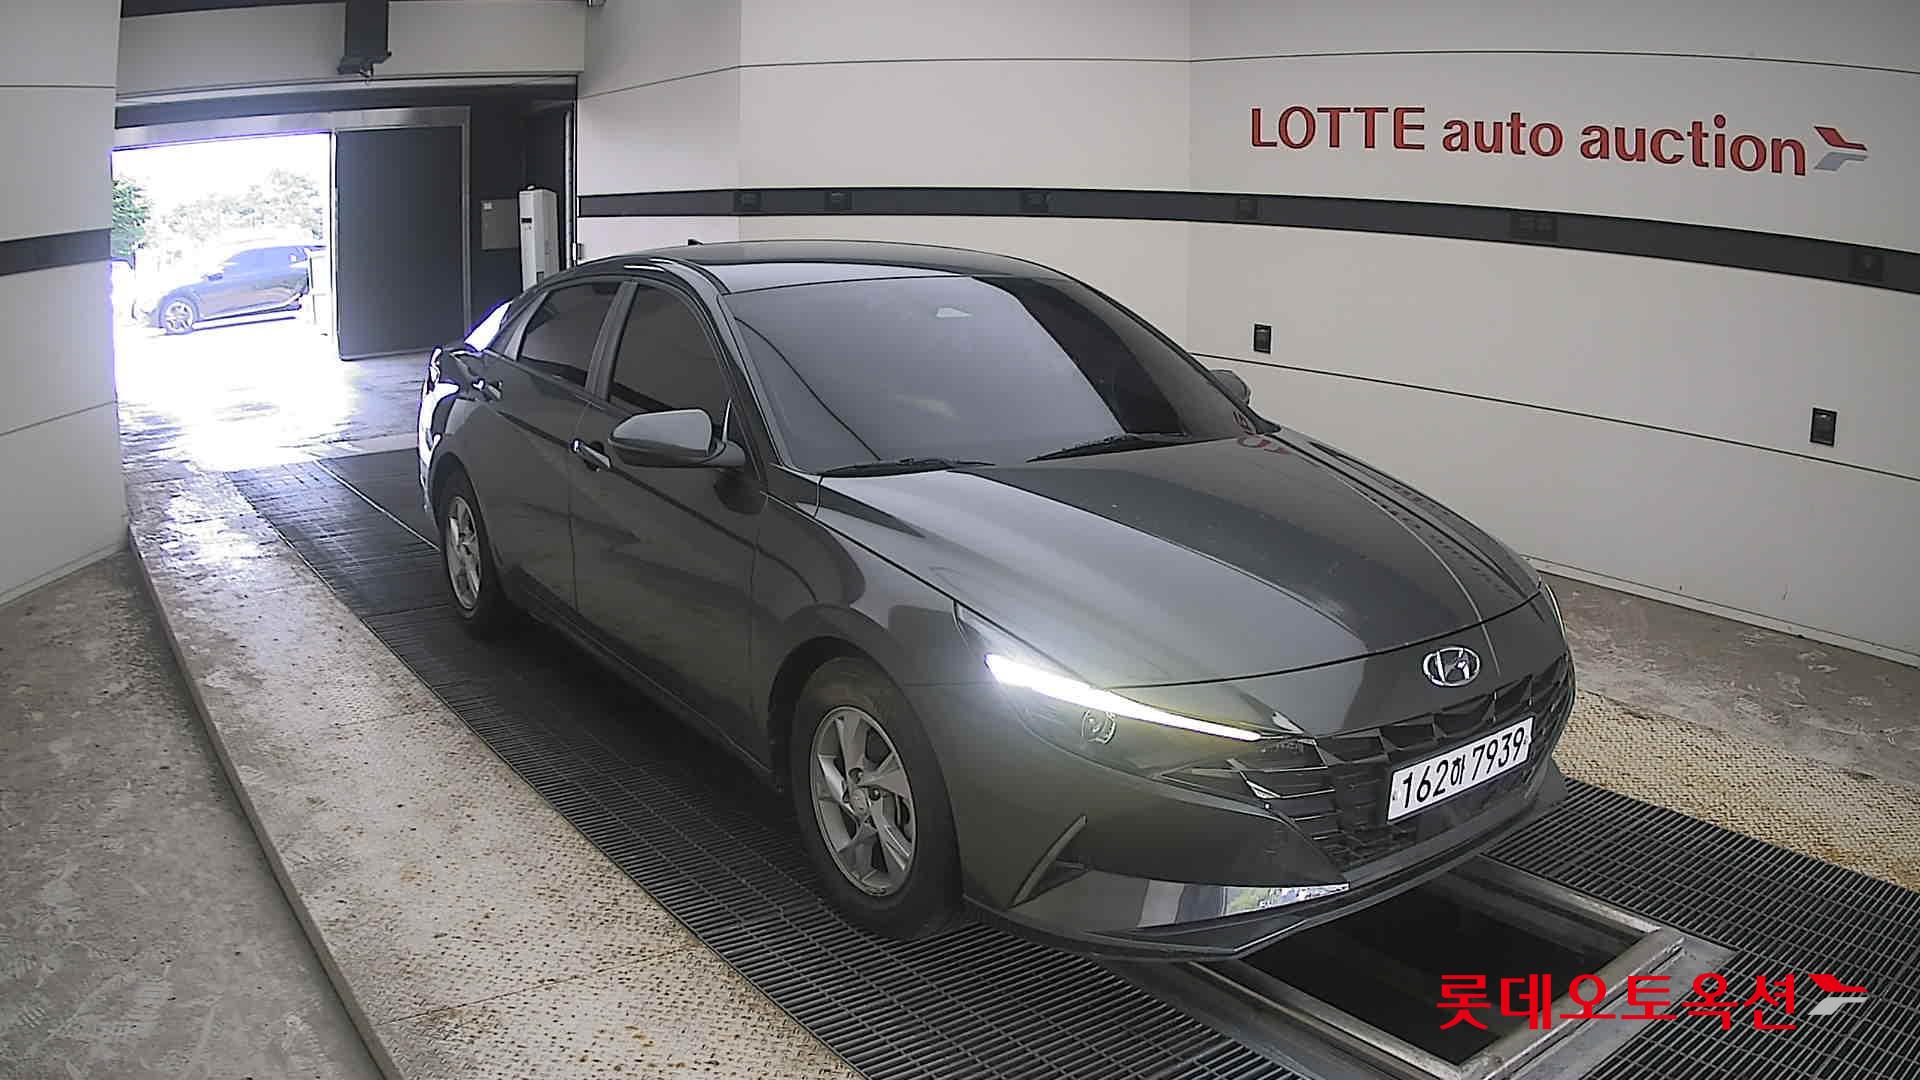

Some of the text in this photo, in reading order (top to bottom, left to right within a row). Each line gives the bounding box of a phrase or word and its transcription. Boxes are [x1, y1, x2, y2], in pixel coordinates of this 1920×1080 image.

[1251, 106, 1806, 177] LOTTE auto auction
[1402, 727, 1525, 809] 162하 7939
